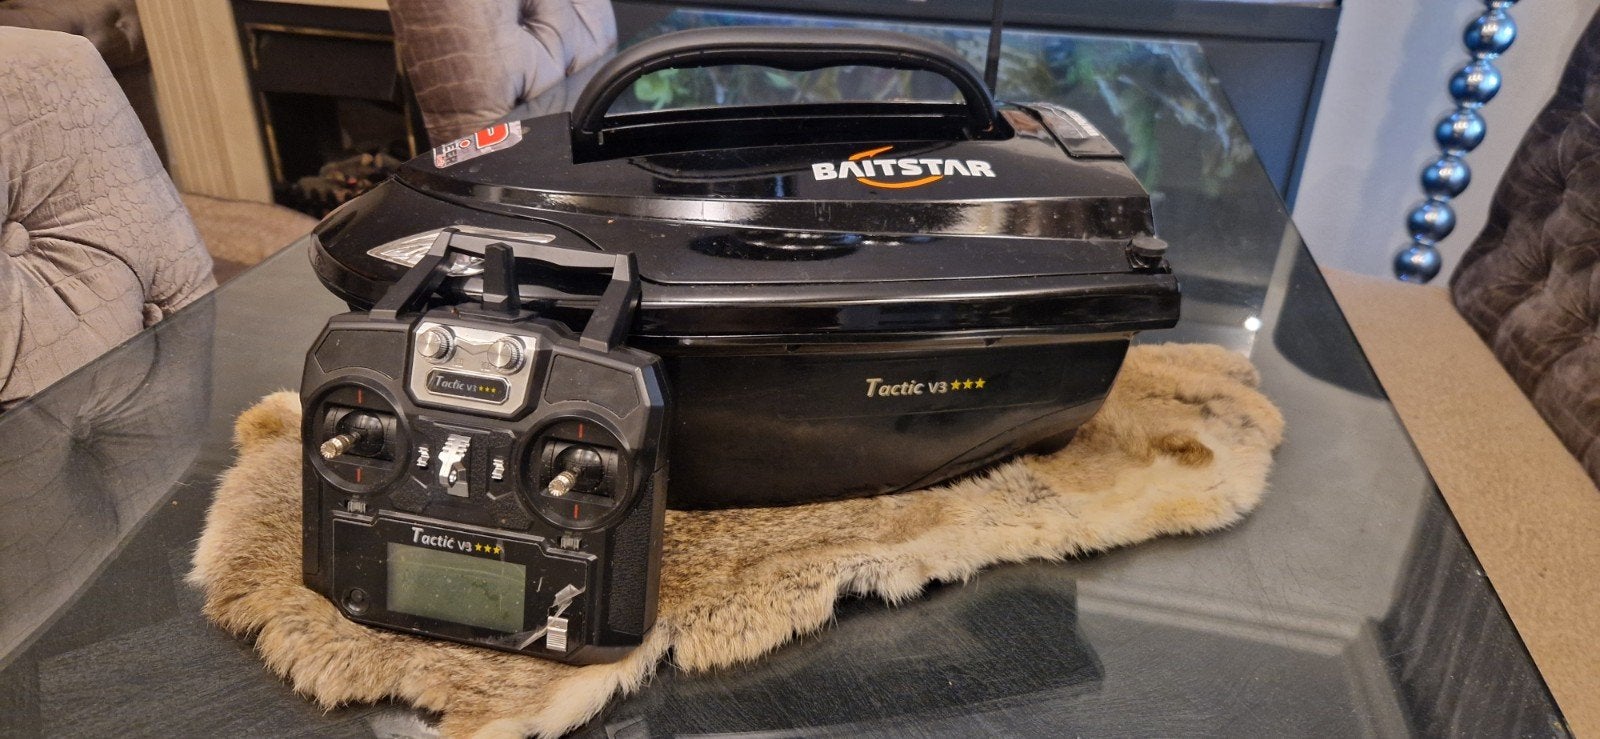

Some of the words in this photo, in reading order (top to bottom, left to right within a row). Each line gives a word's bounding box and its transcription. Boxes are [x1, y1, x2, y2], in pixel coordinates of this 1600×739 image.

[812, 158, 996, 181] BAITSTAR
[435, 375, 465, 390] Tactic
[866, 377, 925, 398] Tactic
[411, 526, 454, 549] Tactic
